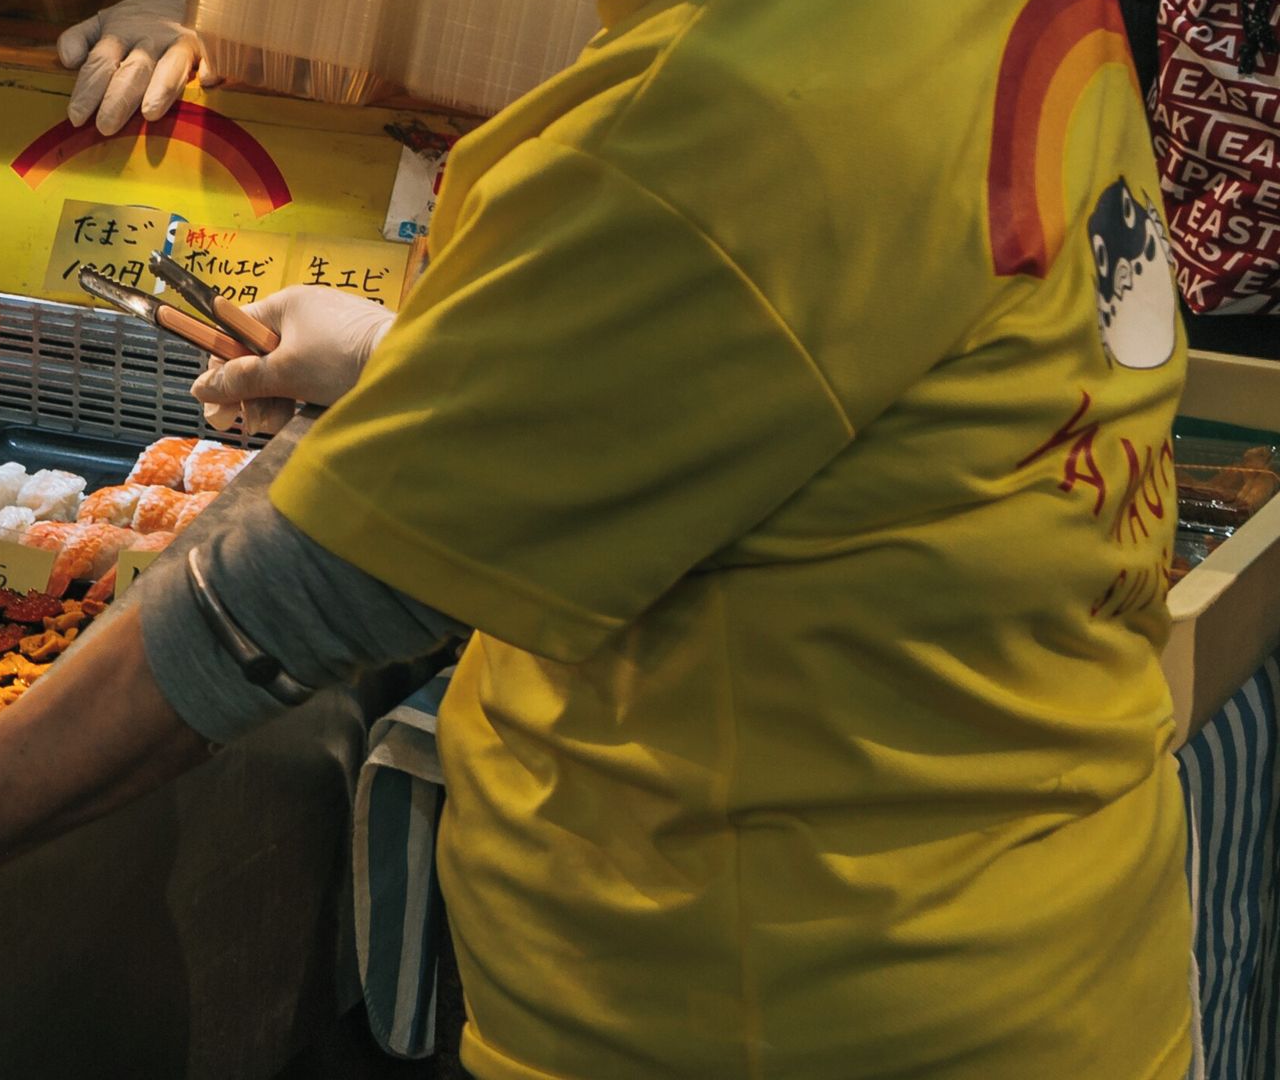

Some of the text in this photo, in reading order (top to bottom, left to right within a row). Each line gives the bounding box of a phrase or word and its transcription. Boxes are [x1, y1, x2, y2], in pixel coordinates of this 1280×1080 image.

[73, 215, 154, 247] たまご
[183, 250, 274, 278] ボイルエビ
[303, 254, 391, 293] 生エビ
